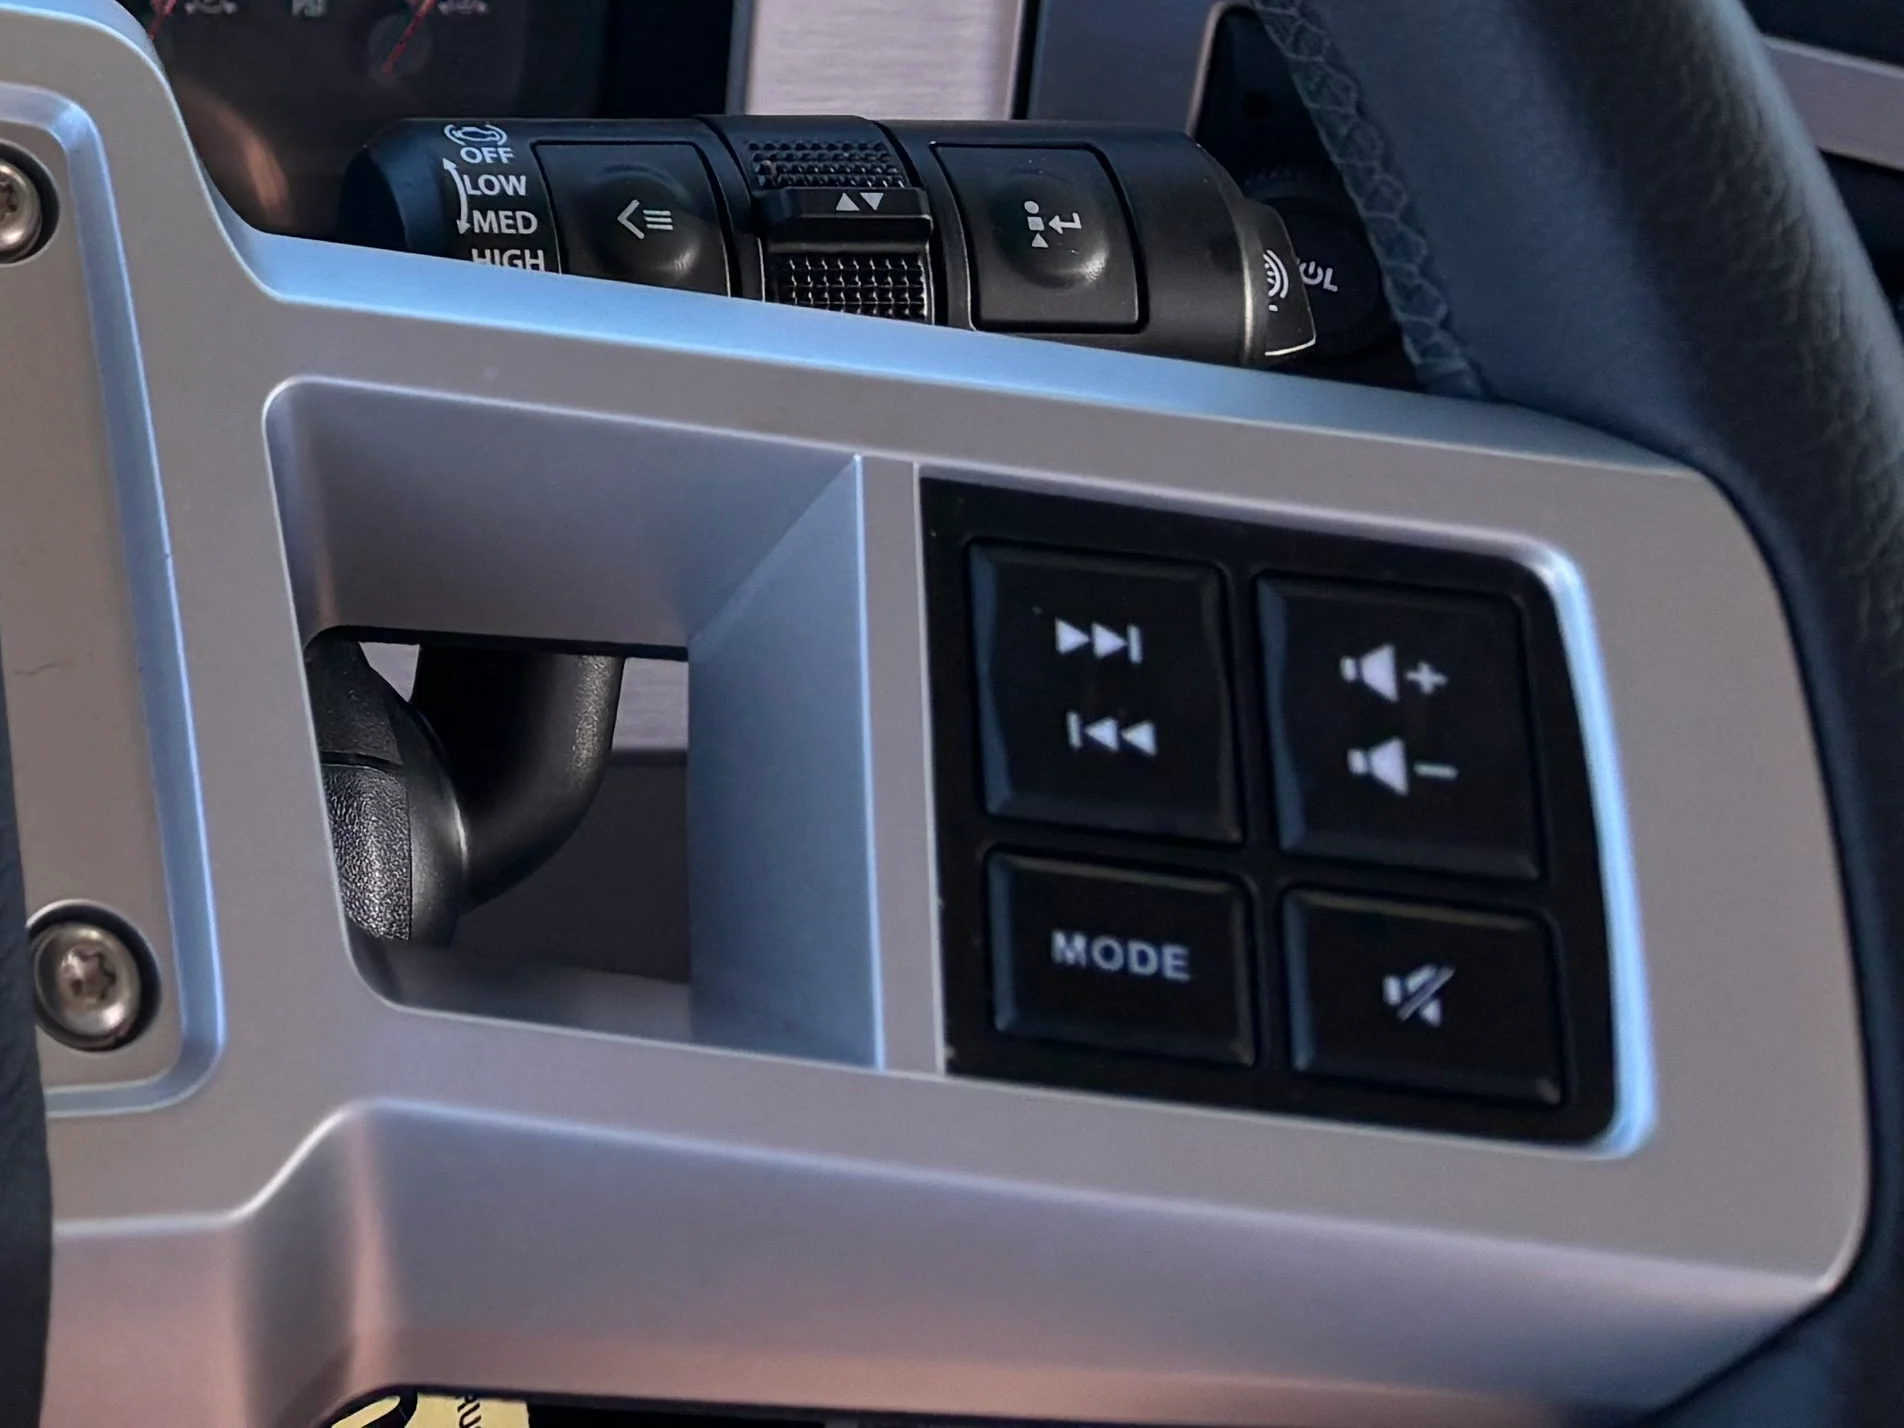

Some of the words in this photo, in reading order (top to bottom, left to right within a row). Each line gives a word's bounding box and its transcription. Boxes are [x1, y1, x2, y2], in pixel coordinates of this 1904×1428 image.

[460, 147, 515, 164] OFF
[463, 174, 527, 196] LOW
[472, 210, 538, 235] MED
[471, 248, 545, 272] HIGH
[1053, 931, 1189, 980] MODE
